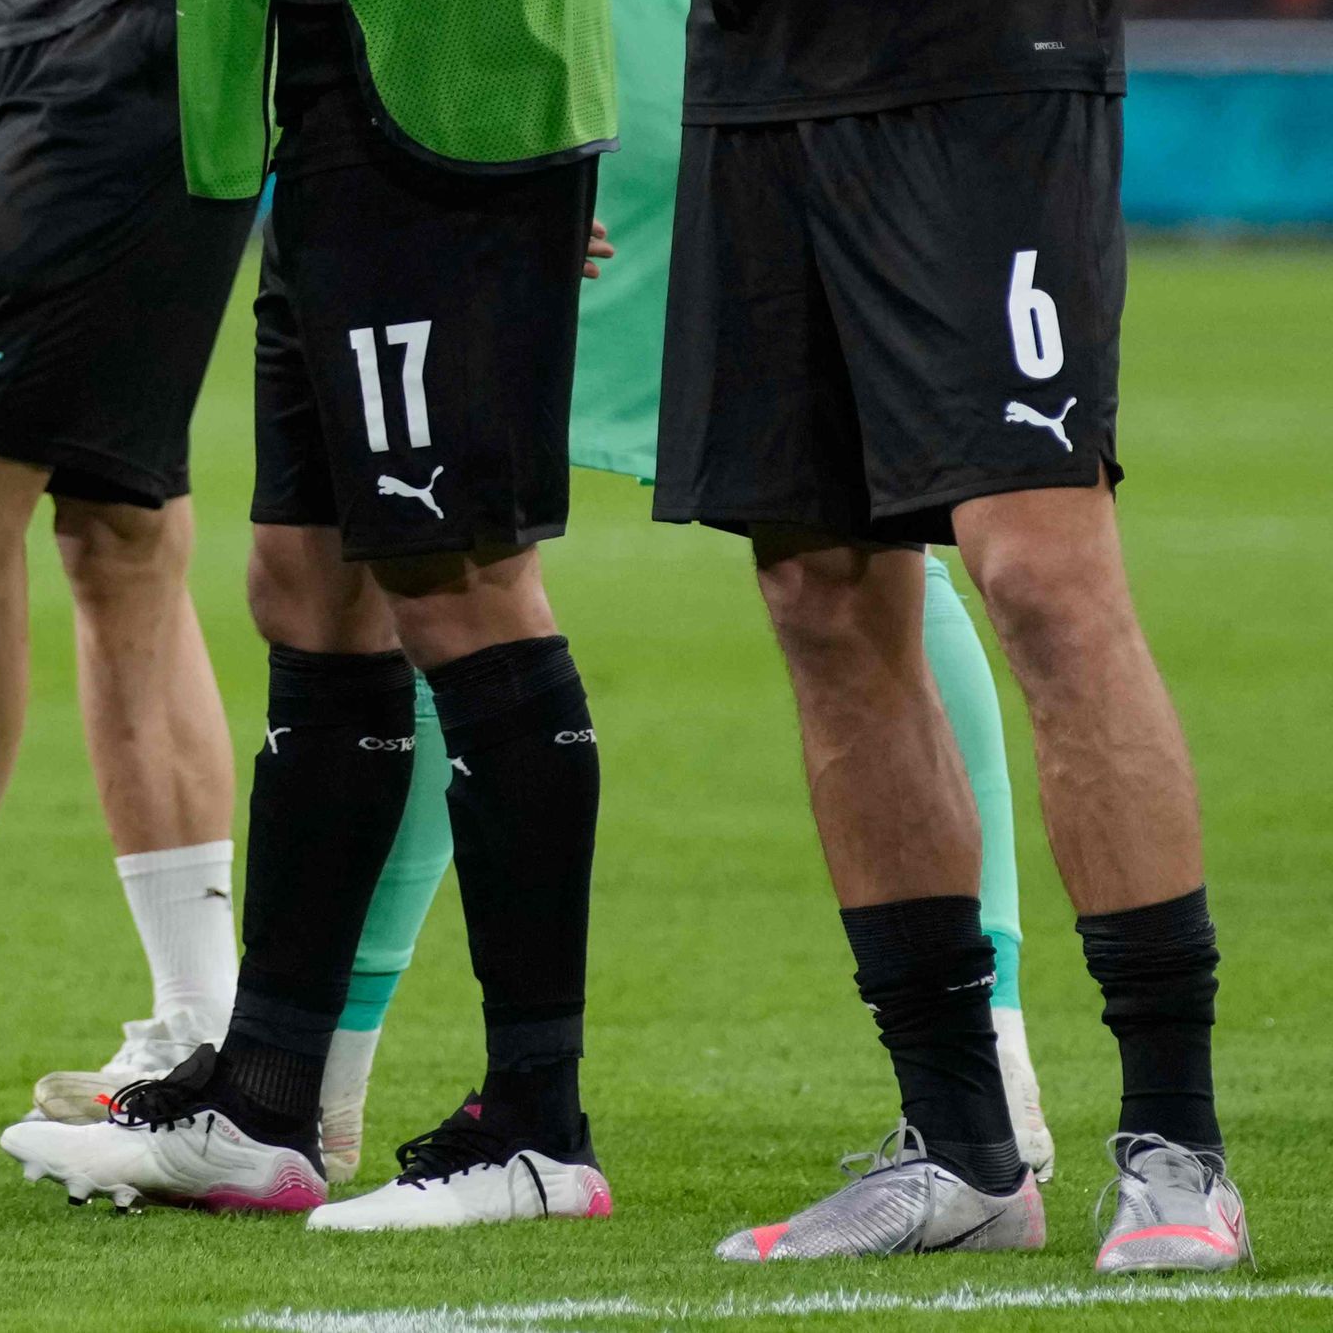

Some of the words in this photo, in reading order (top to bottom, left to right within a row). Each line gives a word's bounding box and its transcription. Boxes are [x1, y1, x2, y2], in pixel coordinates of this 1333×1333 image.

[1034, 41, 1066, 51] DRYCELL
[1008, 249, 1065, 380] 6
[348, 319, 433, 453] 17
